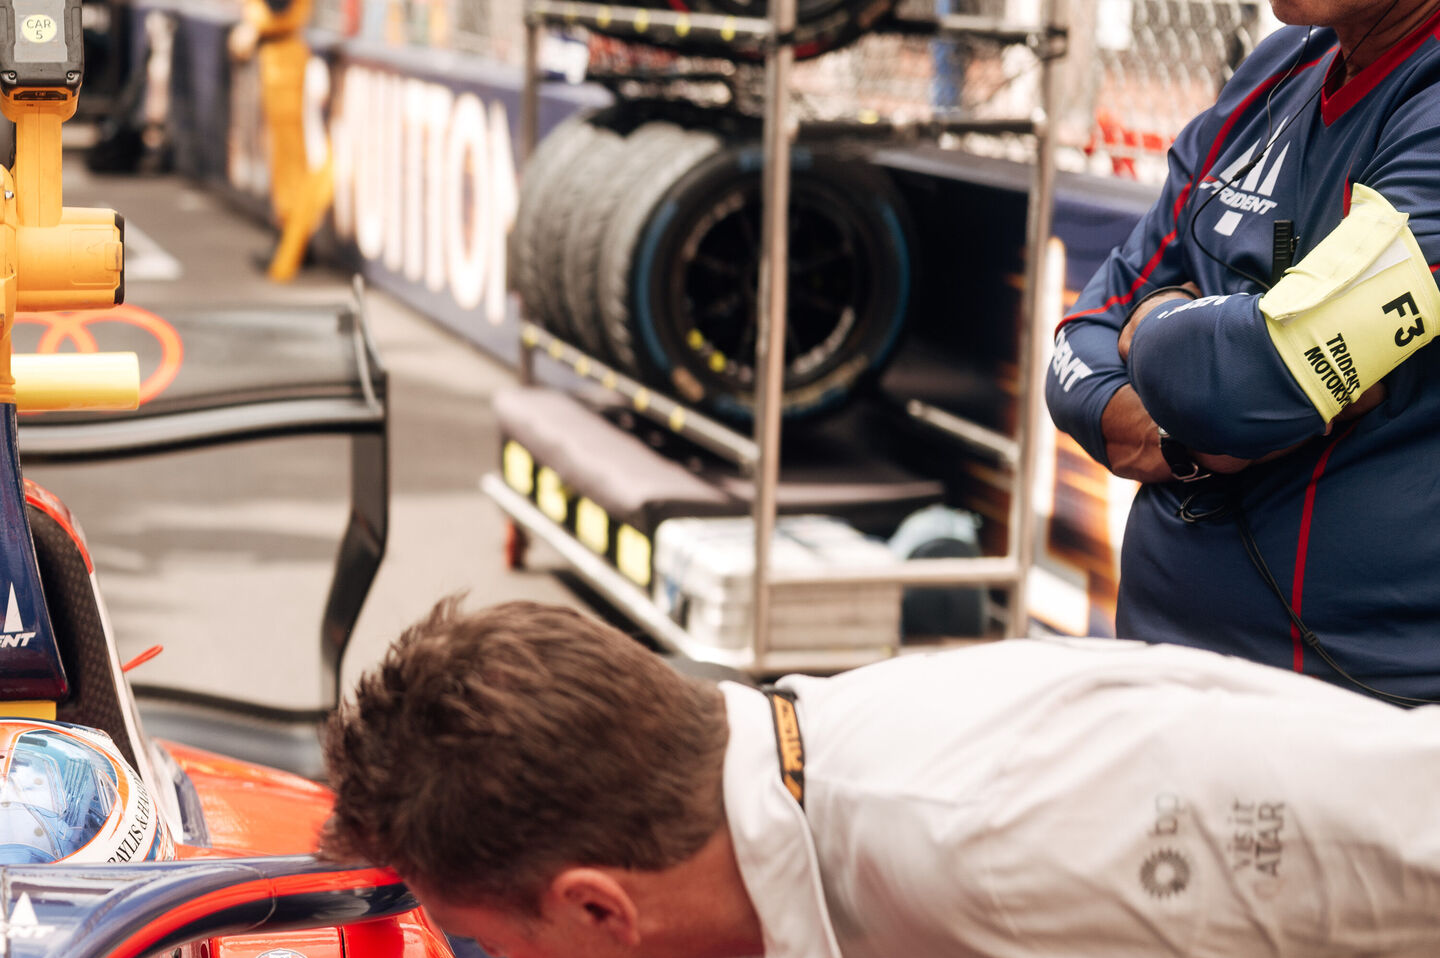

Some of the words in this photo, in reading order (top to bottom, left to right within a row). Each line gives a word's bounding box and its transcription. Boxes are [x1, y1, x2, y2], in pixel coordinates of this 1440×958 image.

[26, 18, 51, 29] CAR
[35, 29, 43, 40] 5
[1381, 291, 1425, 347] F3
